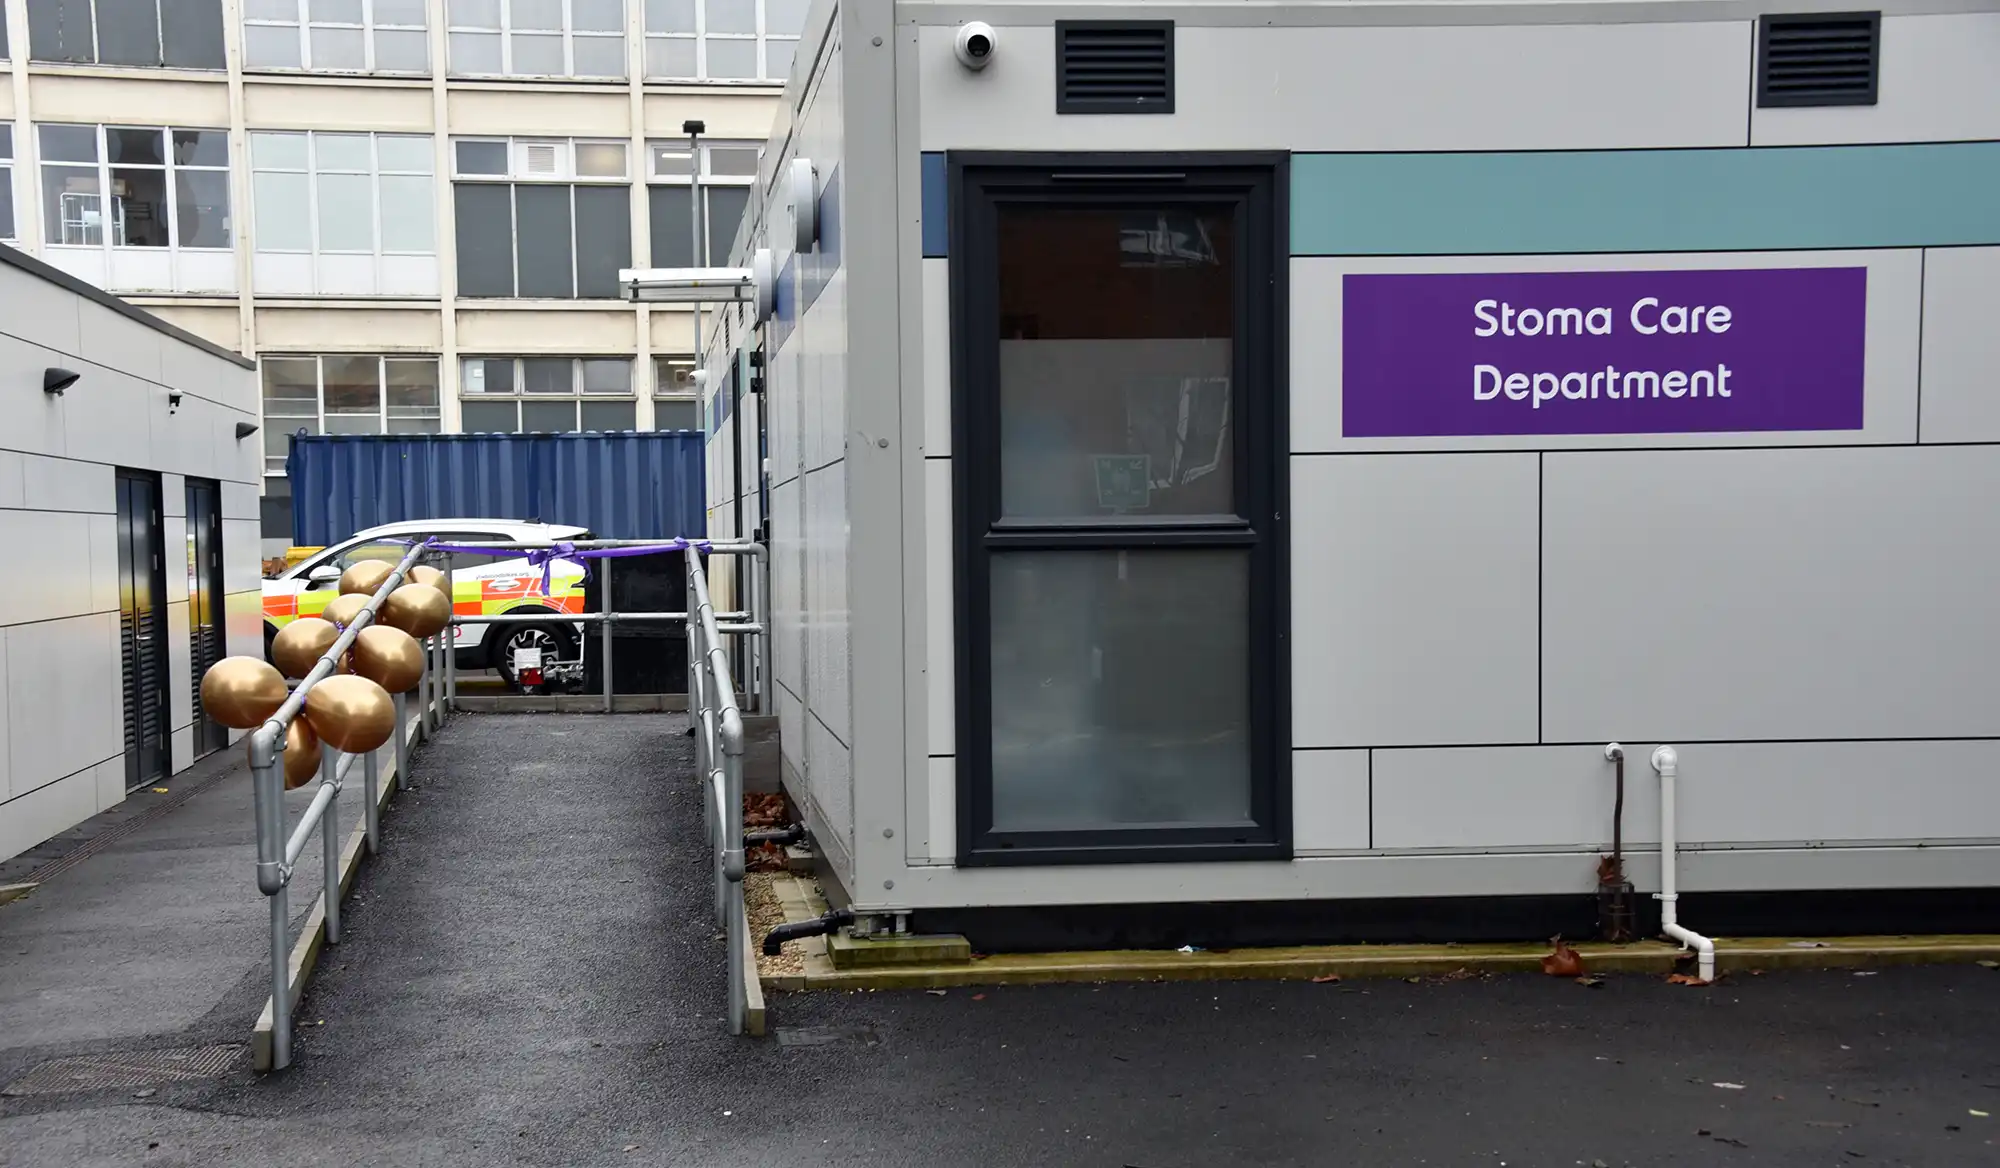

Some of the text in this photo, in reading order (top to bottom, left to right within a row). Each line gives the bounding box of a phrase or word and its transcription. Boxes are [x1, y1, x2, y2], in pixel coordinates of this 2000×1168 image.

[1473, 297, 1733, 337] Stoma Care
[1473, 363, 1733, 409] Department
